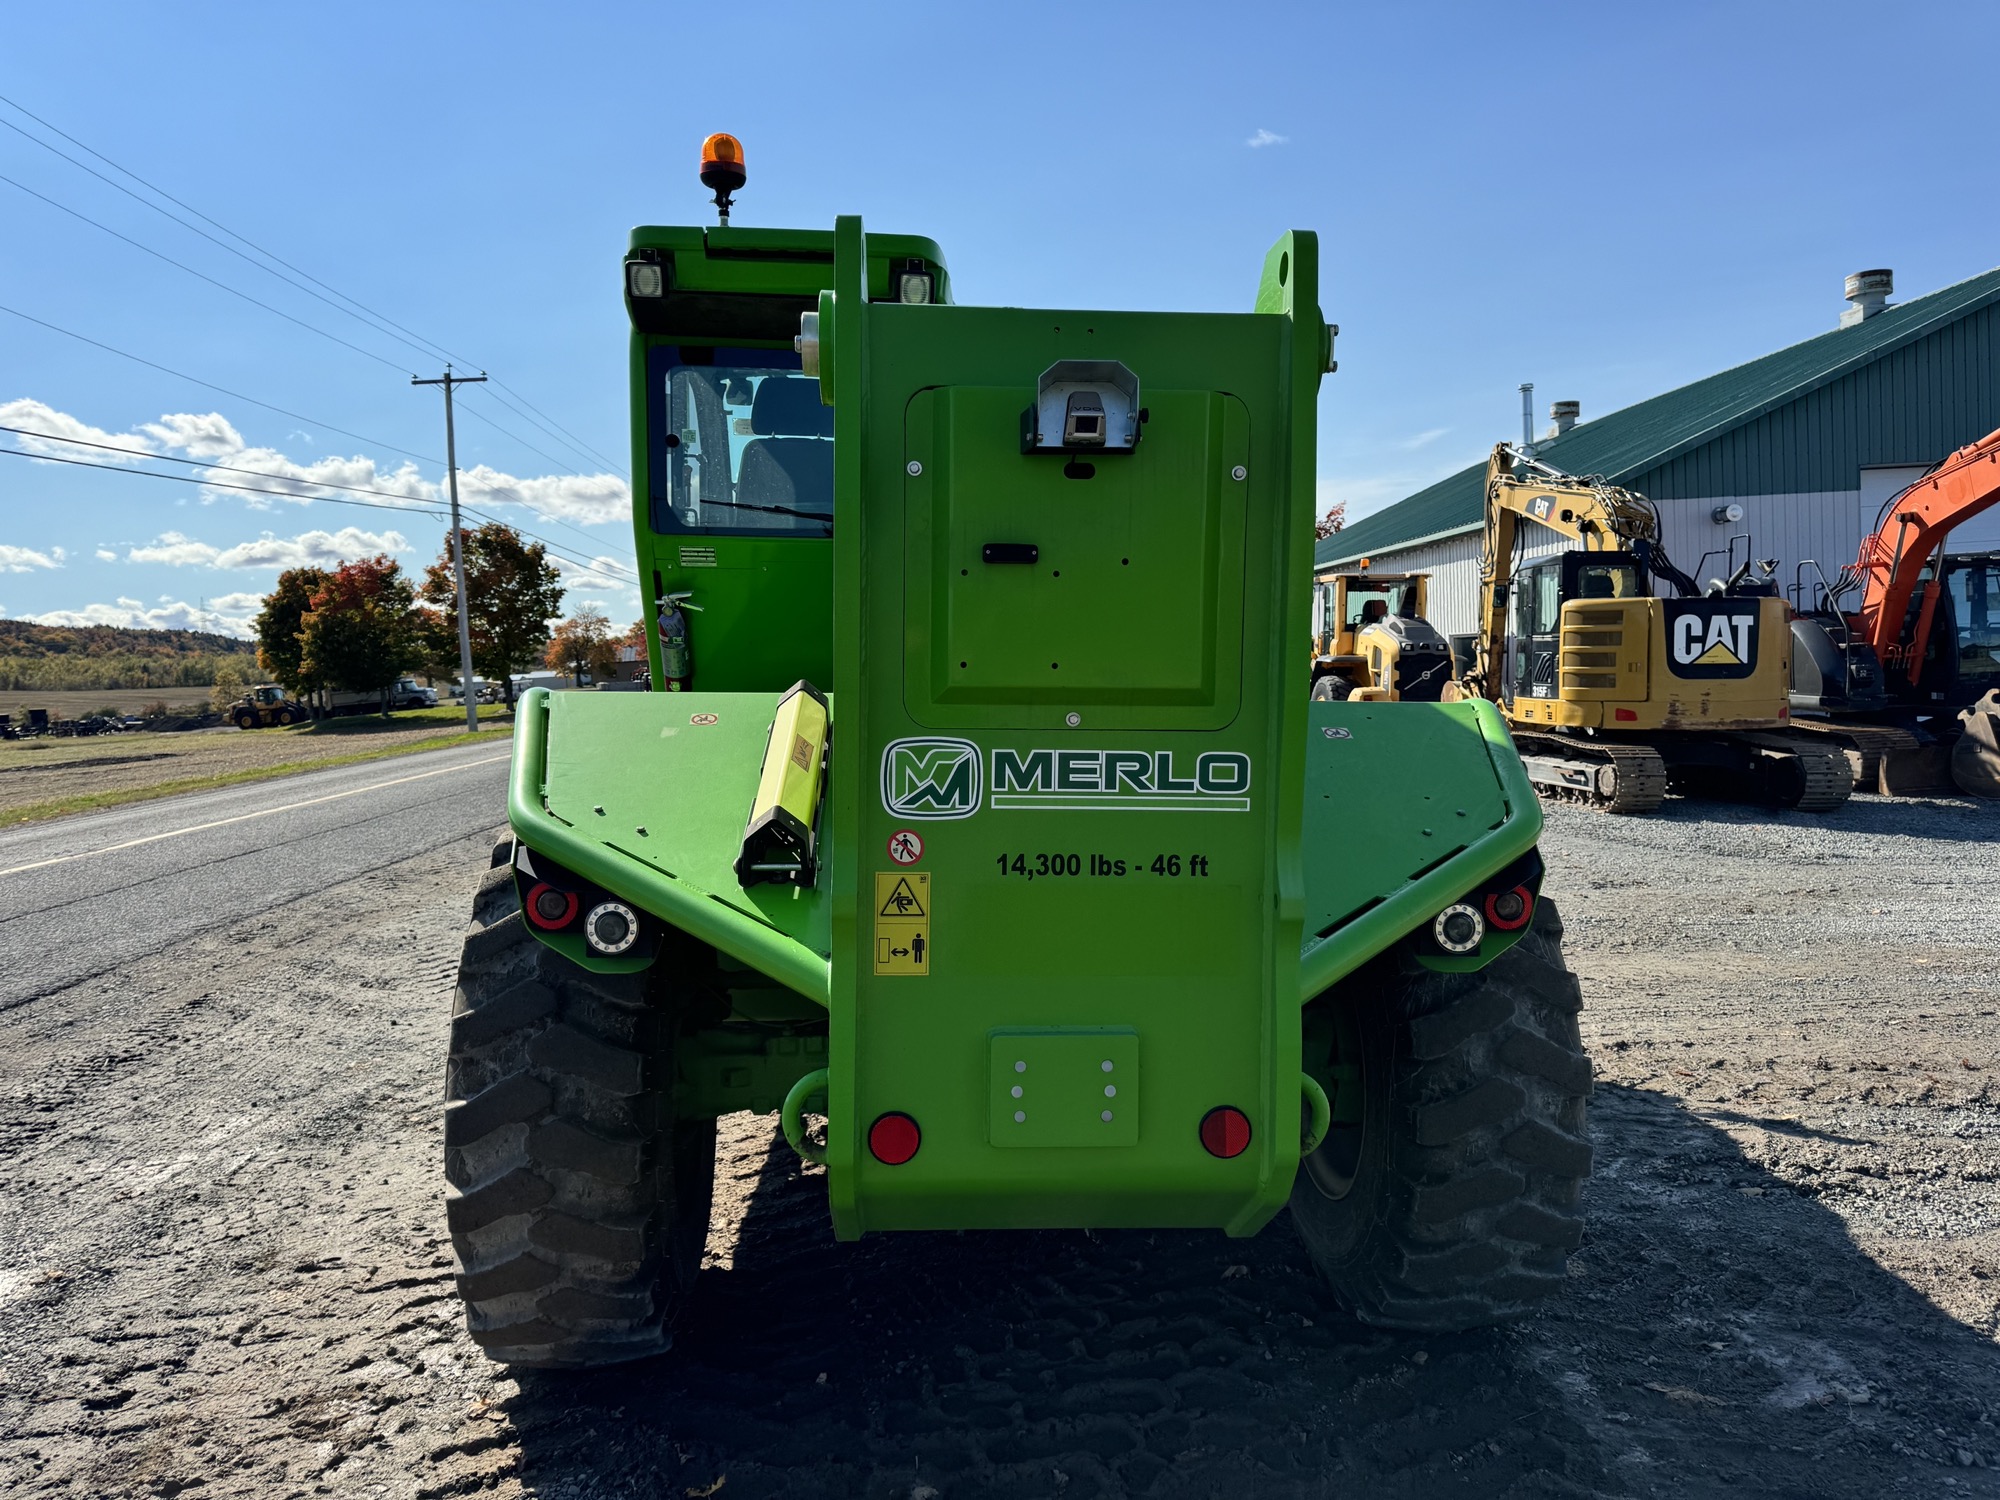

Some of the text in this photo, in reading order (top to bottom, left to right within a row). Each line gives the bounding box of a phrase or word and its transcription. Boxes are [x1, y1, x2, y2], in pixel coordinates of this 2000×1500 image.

[1534, 497, 1549, 519] CAT
[1673, 613, 1754, 665] CAT
[991, 749, 1250, 795] MERLO
[996, 853, 1081, 881] 14,300
[1090, 853, 1127, 877] lbs
[1150, 853, 1182, 877] 46
[1189, 854, 1209, 877] ft
